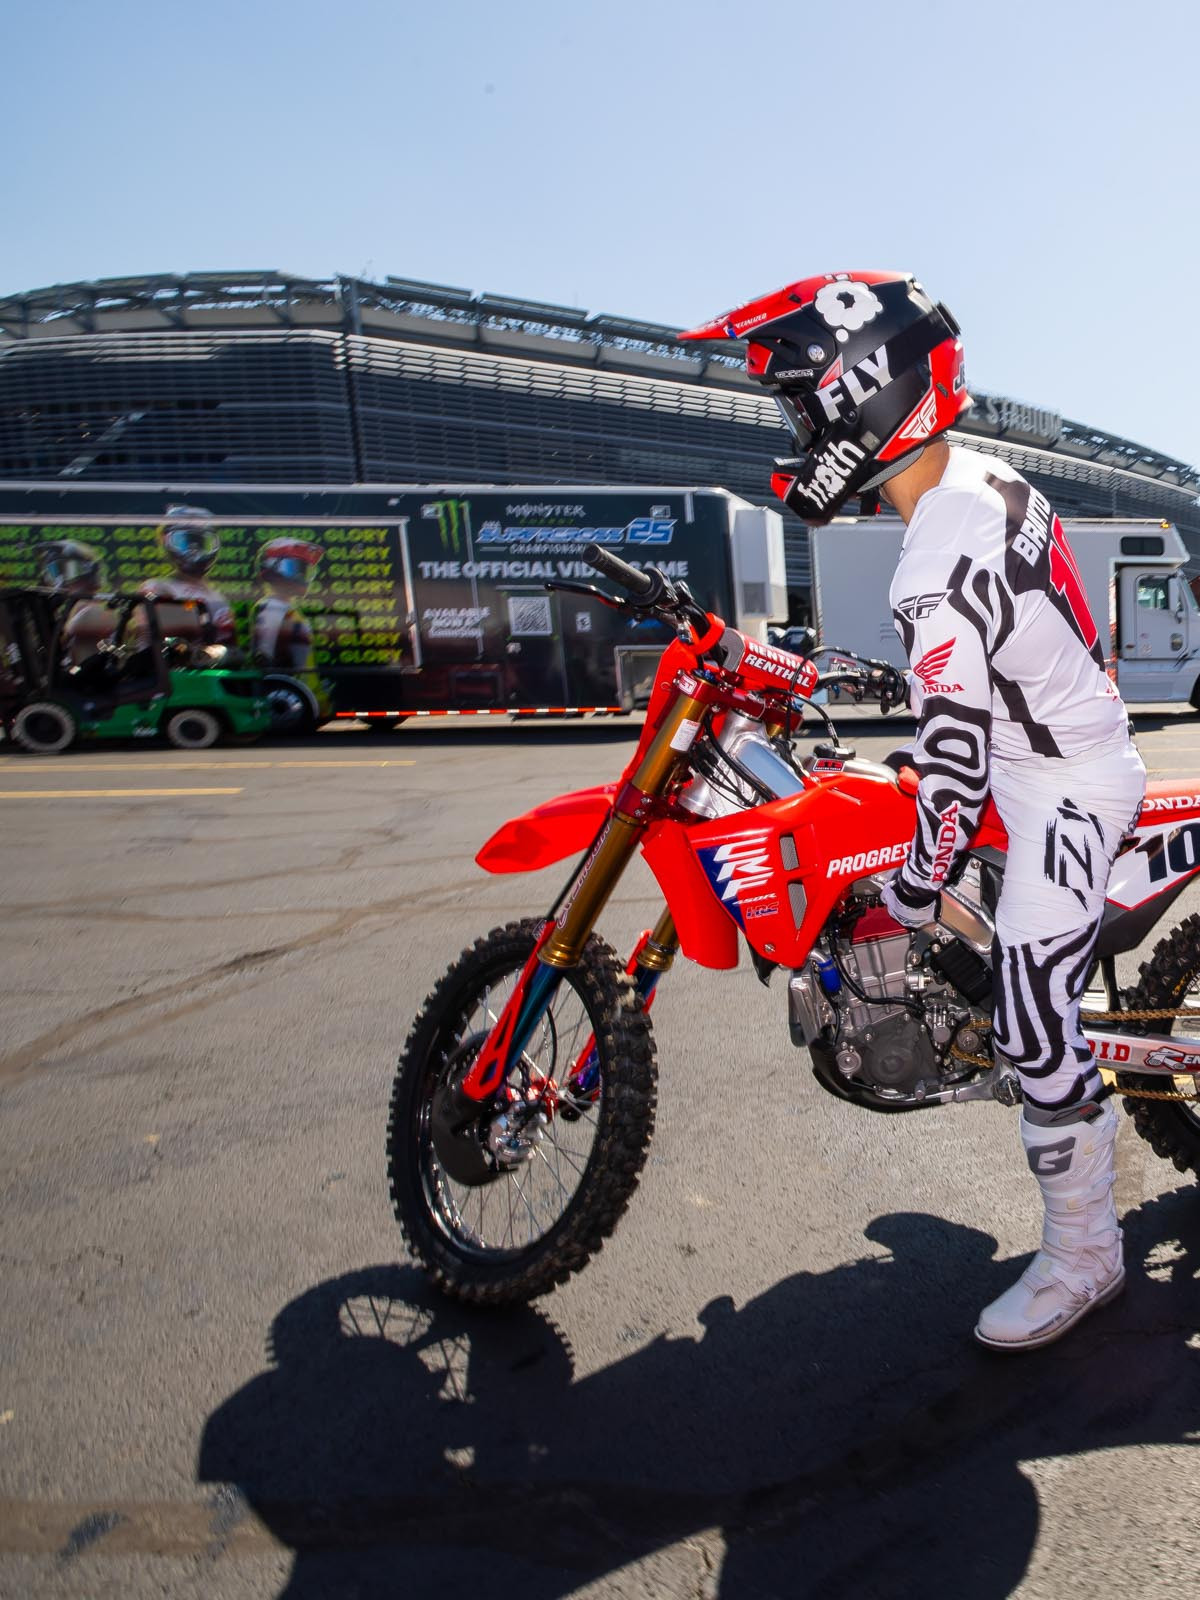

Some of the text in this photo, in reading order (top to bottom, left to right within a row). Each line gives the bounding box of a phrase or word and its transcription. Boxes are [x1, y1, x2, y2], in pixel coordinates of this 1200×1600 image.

[815, 344, 894, 422] FLY
[505, 503, 586, 518] MONSTER
[323, 528, 388, 543] GLORY
[509, 543, 590, 555] CHAMPIONSHI
[328, 563, 392, 579] GLORY
[419, 561, 460, 578] THE
[461, 561, 555, 579] OFFICIAL
[557, 561, 606, 578] VID
[331, 580, 395, 595] GLORY
[333, 599, 397, 613] GLORY
[335, 615, 399, 630] GLORY
[337, 632, 401, 648] GLORY
[339, 650, 403, 665] GLORY
[922, 684, 965, 695] NDA
[931, 801, 961, 883] HONDA
[713, 837, 774, 900] CRF
